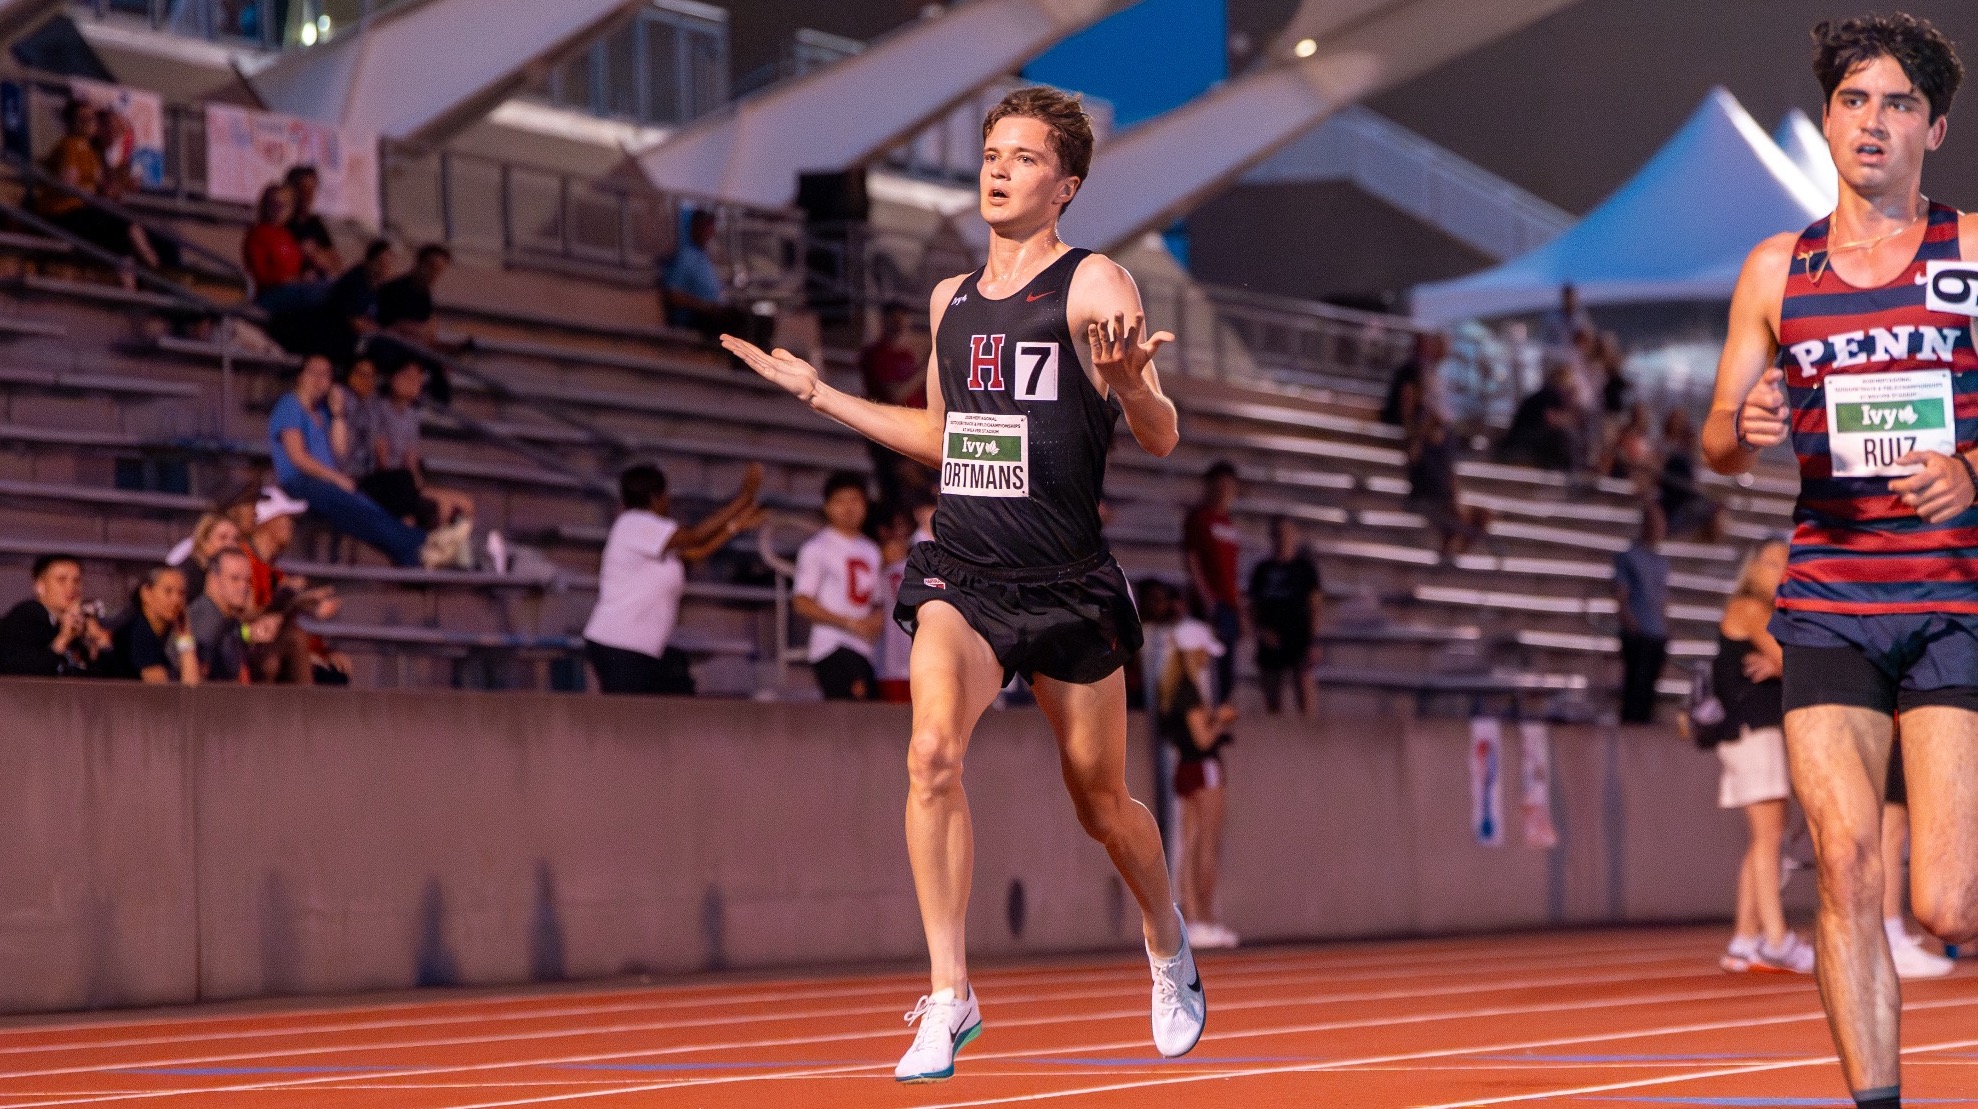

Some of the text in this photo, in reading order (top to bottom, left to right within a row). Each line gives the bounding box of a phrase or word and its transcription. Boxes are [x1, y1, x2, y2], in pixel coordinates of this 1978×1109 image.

[967, 334, 1006, 391] H
[1020, 346, 1051, 396] 7
[1790, 325, 1961, 378] PENN
[1861, 404, 1898, 430] Ivy
[961, 436, 985, 458] Ivy
[944, 461, 1024, 490] ORTMANS
[846, 556, 870, 606] C
